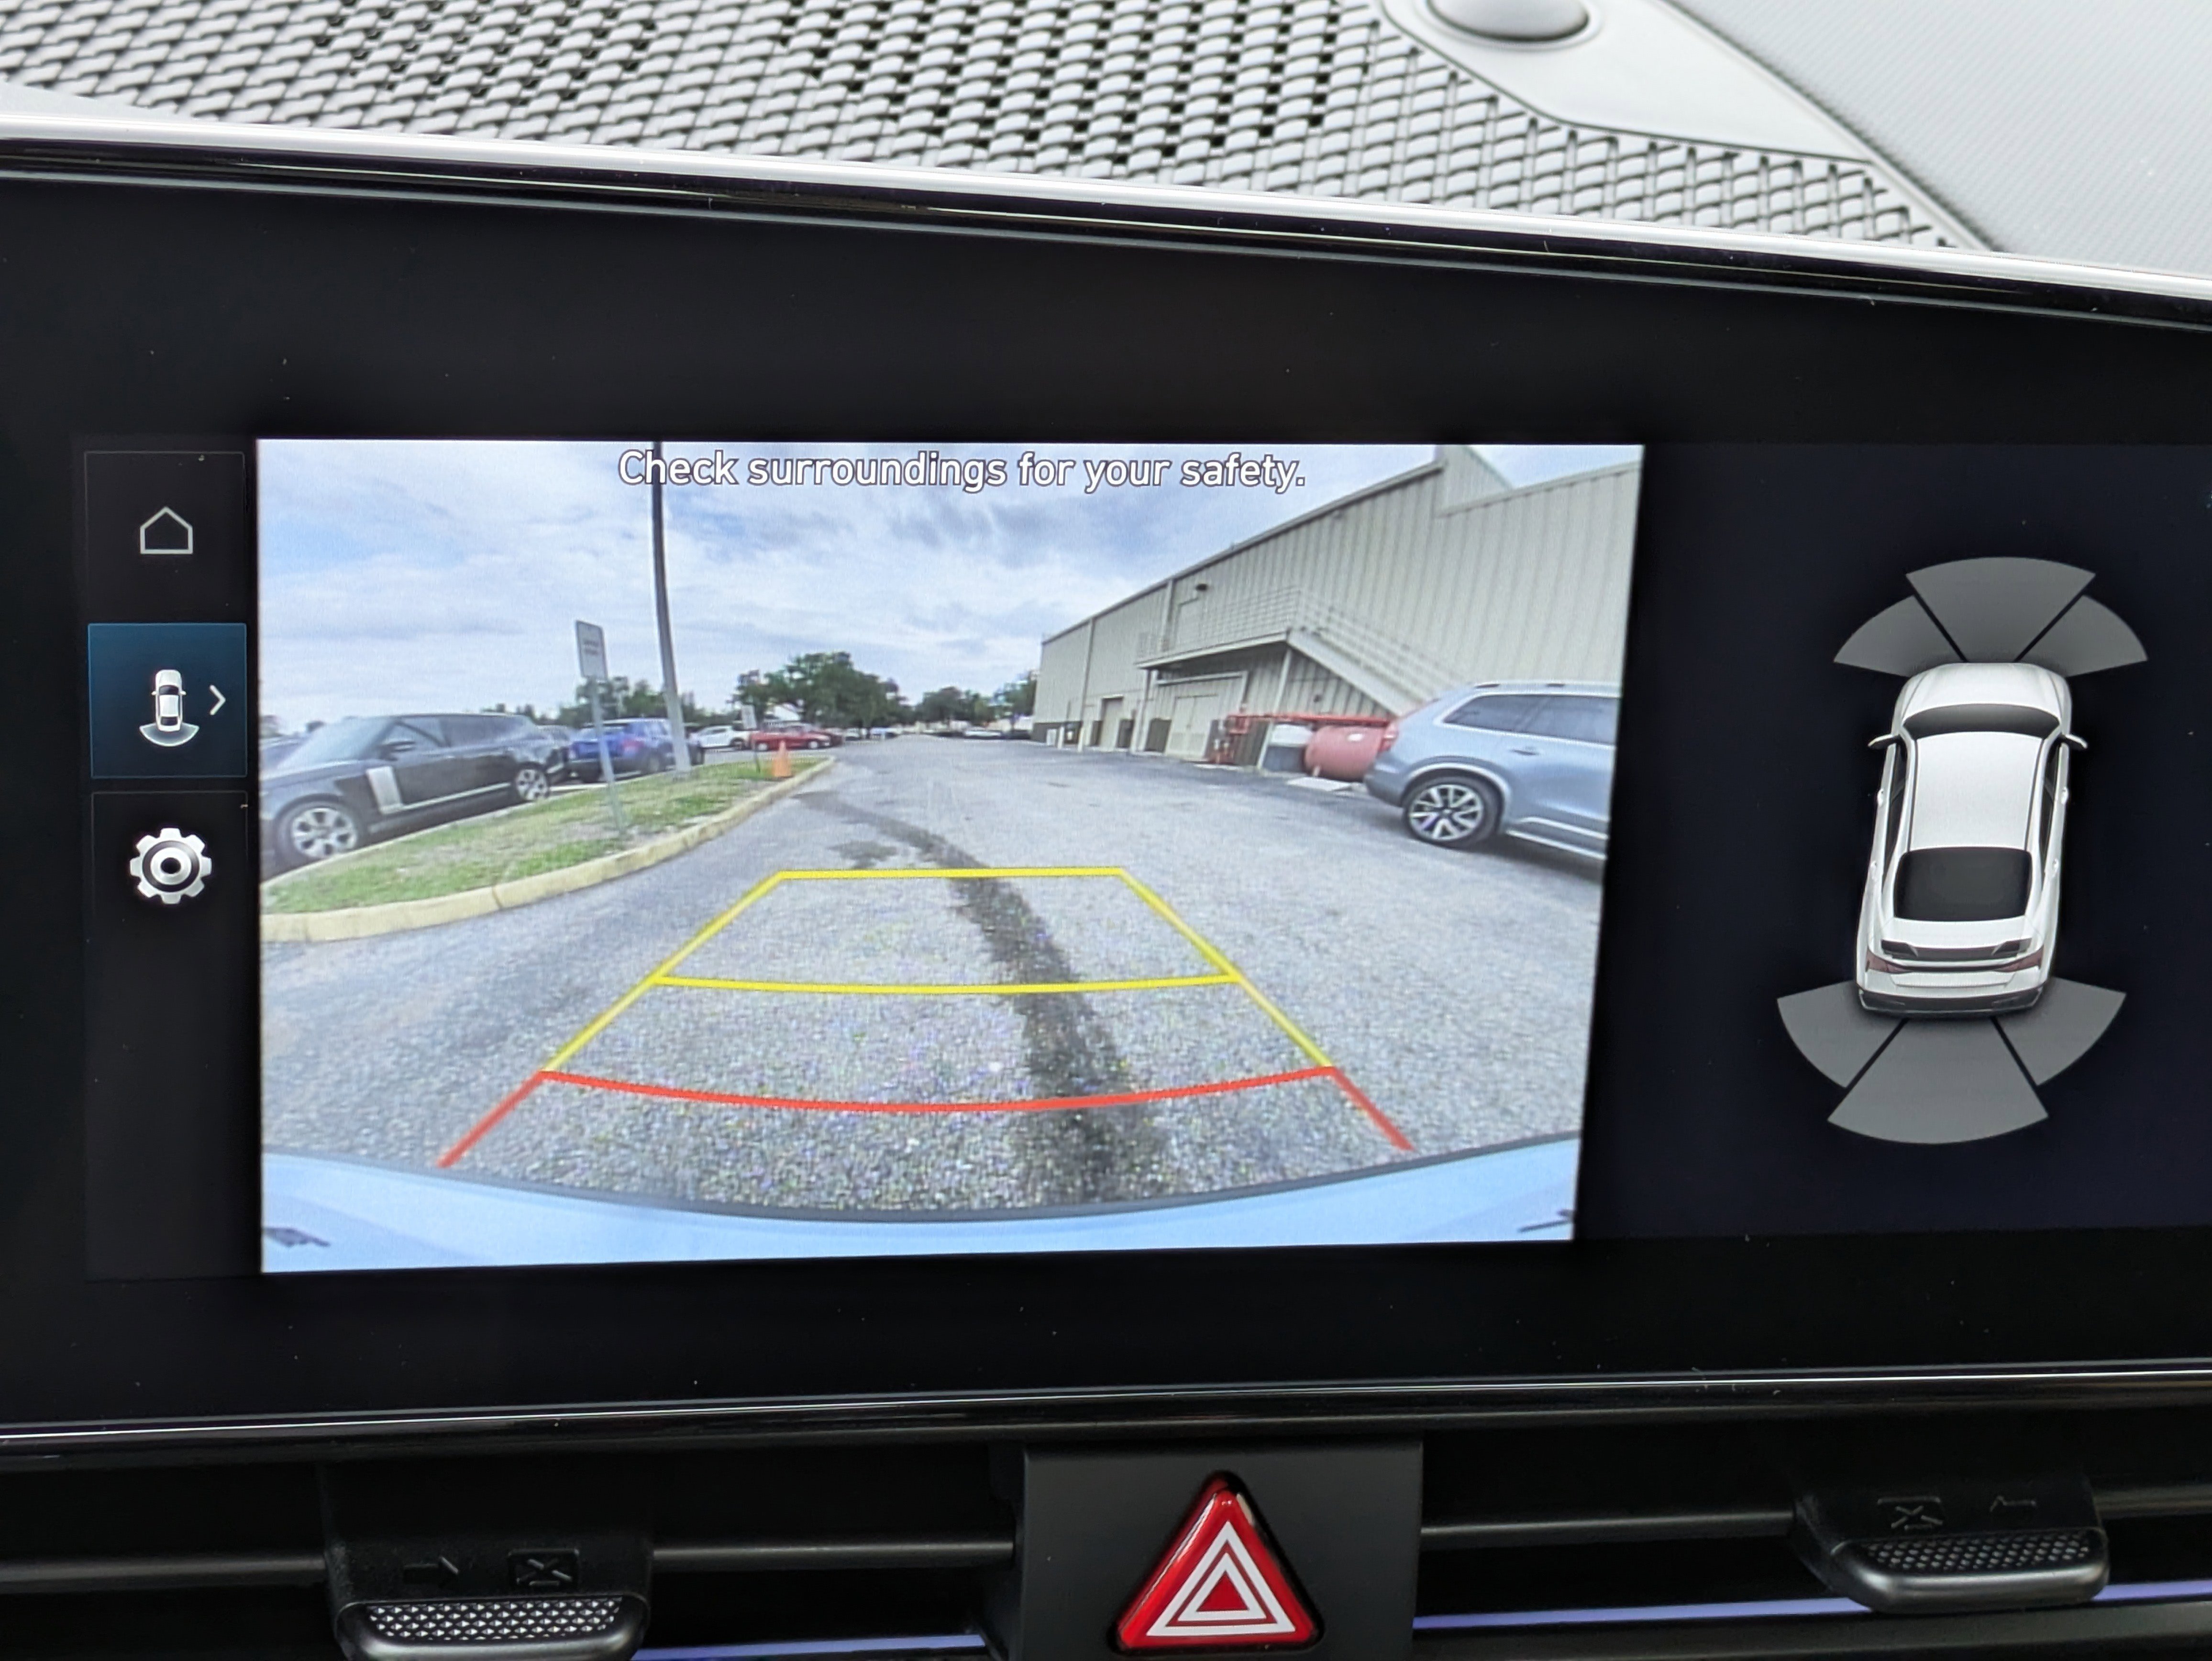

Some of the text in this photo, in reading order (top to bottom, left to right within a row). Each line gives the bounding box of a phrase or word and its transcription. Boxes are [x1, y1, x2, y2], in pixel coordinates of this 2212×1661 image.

[618, 449, 1306, 495] Check surroundings for your safety.
